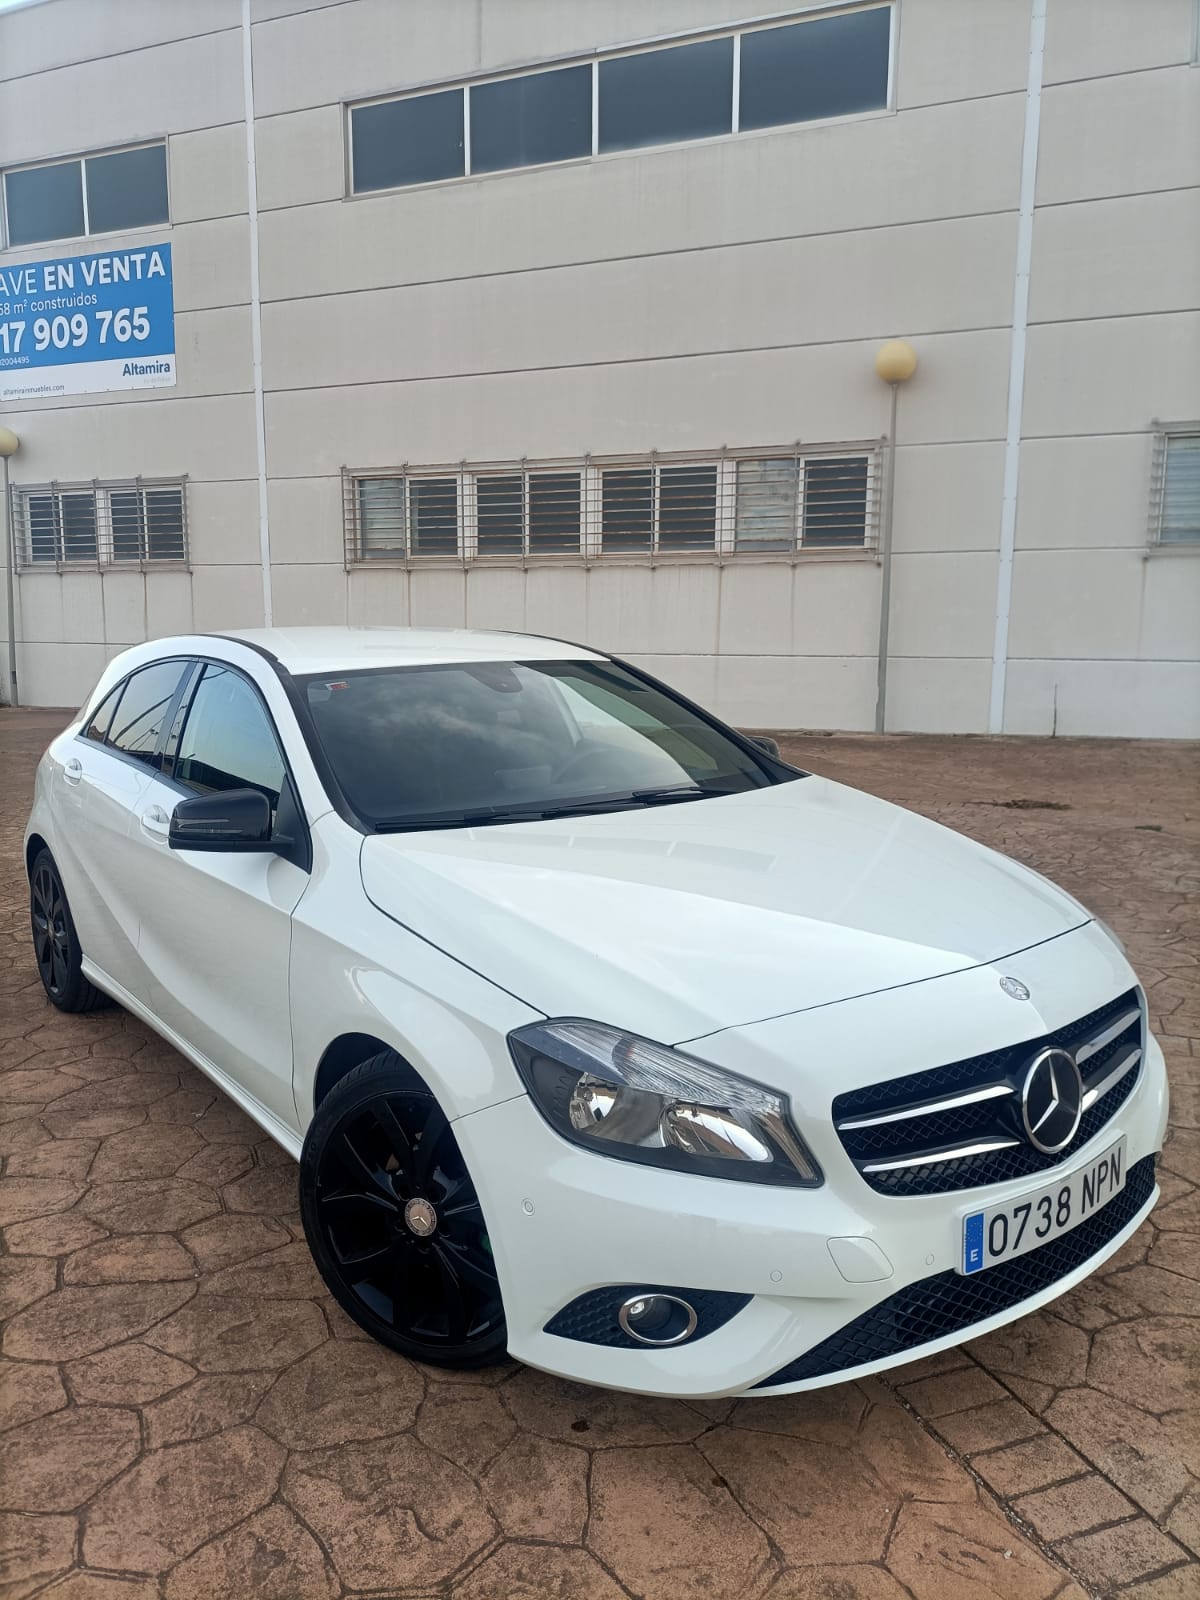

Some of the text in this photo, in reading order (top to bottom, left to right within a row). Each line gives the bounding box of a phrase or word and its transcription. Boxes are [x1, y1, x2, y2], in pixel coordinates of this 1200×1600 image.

[44, 263, 75, 292] EN
[80, 251, 166, 287] VENTA
[30, 293, 98, 312] construidos
[0, 306, 151, 354] 17 909 765
[0, 356, 30, 366] 2004495
[122, 360, 171, 377] Altamira
[970, 1146, 1122, 1262] E 0738 NPN
